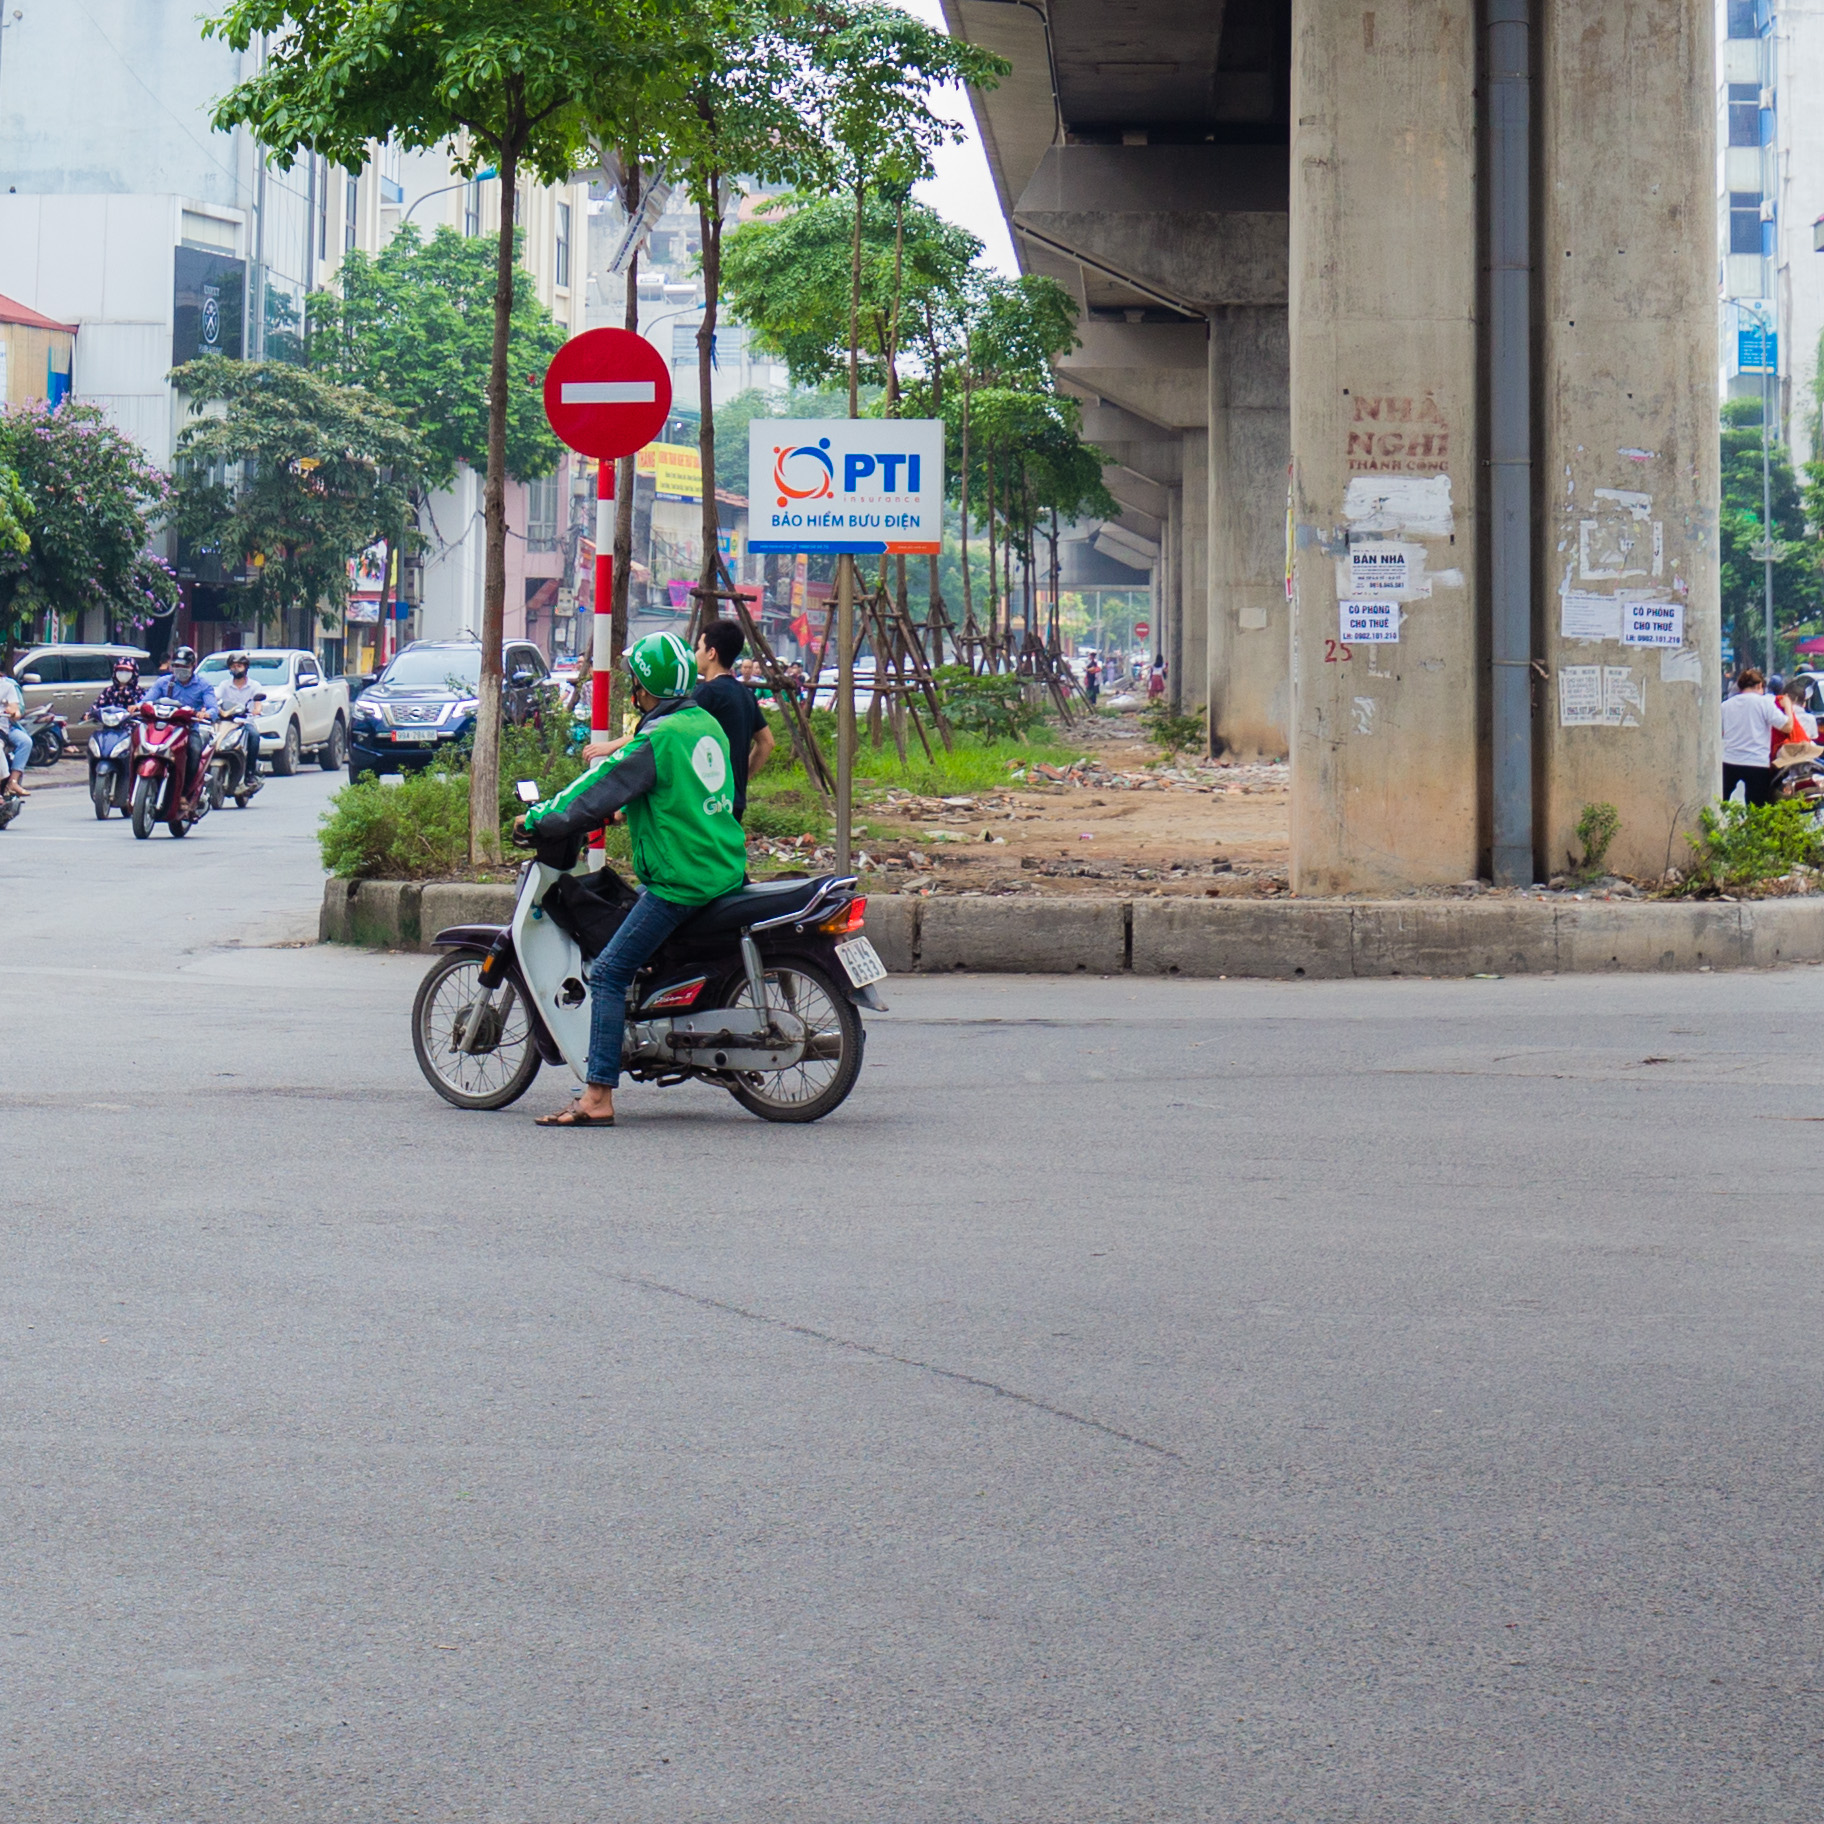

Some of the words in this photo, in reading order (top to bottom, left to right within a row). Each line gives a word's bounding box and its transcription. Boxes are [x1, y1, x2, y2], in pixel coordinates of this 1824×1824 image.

[844, 453, 921, 492] PTI
[844, 495, 921, 503] insurance
[772, 510, 803, 527] BẢO
[807, 510, 844, 527] HIỂM
[848, 513, 880, 527] BƯU
[884, 512, 920, 530] ĐIỆN
[1353, 553, 1377, 564] BÁN
[1380, 553, 1405, 564] NHÀ
[1350, 619, 1366, 628] CHO
[1369, 617, 1389, 628] THUÊ
[1633, 621, 1650, 631] CHO
[1653, 621, 1673, 631] THUÊ
[1324, 640, 1353, 663] 25
[634, 651, 652, 678] Grab
